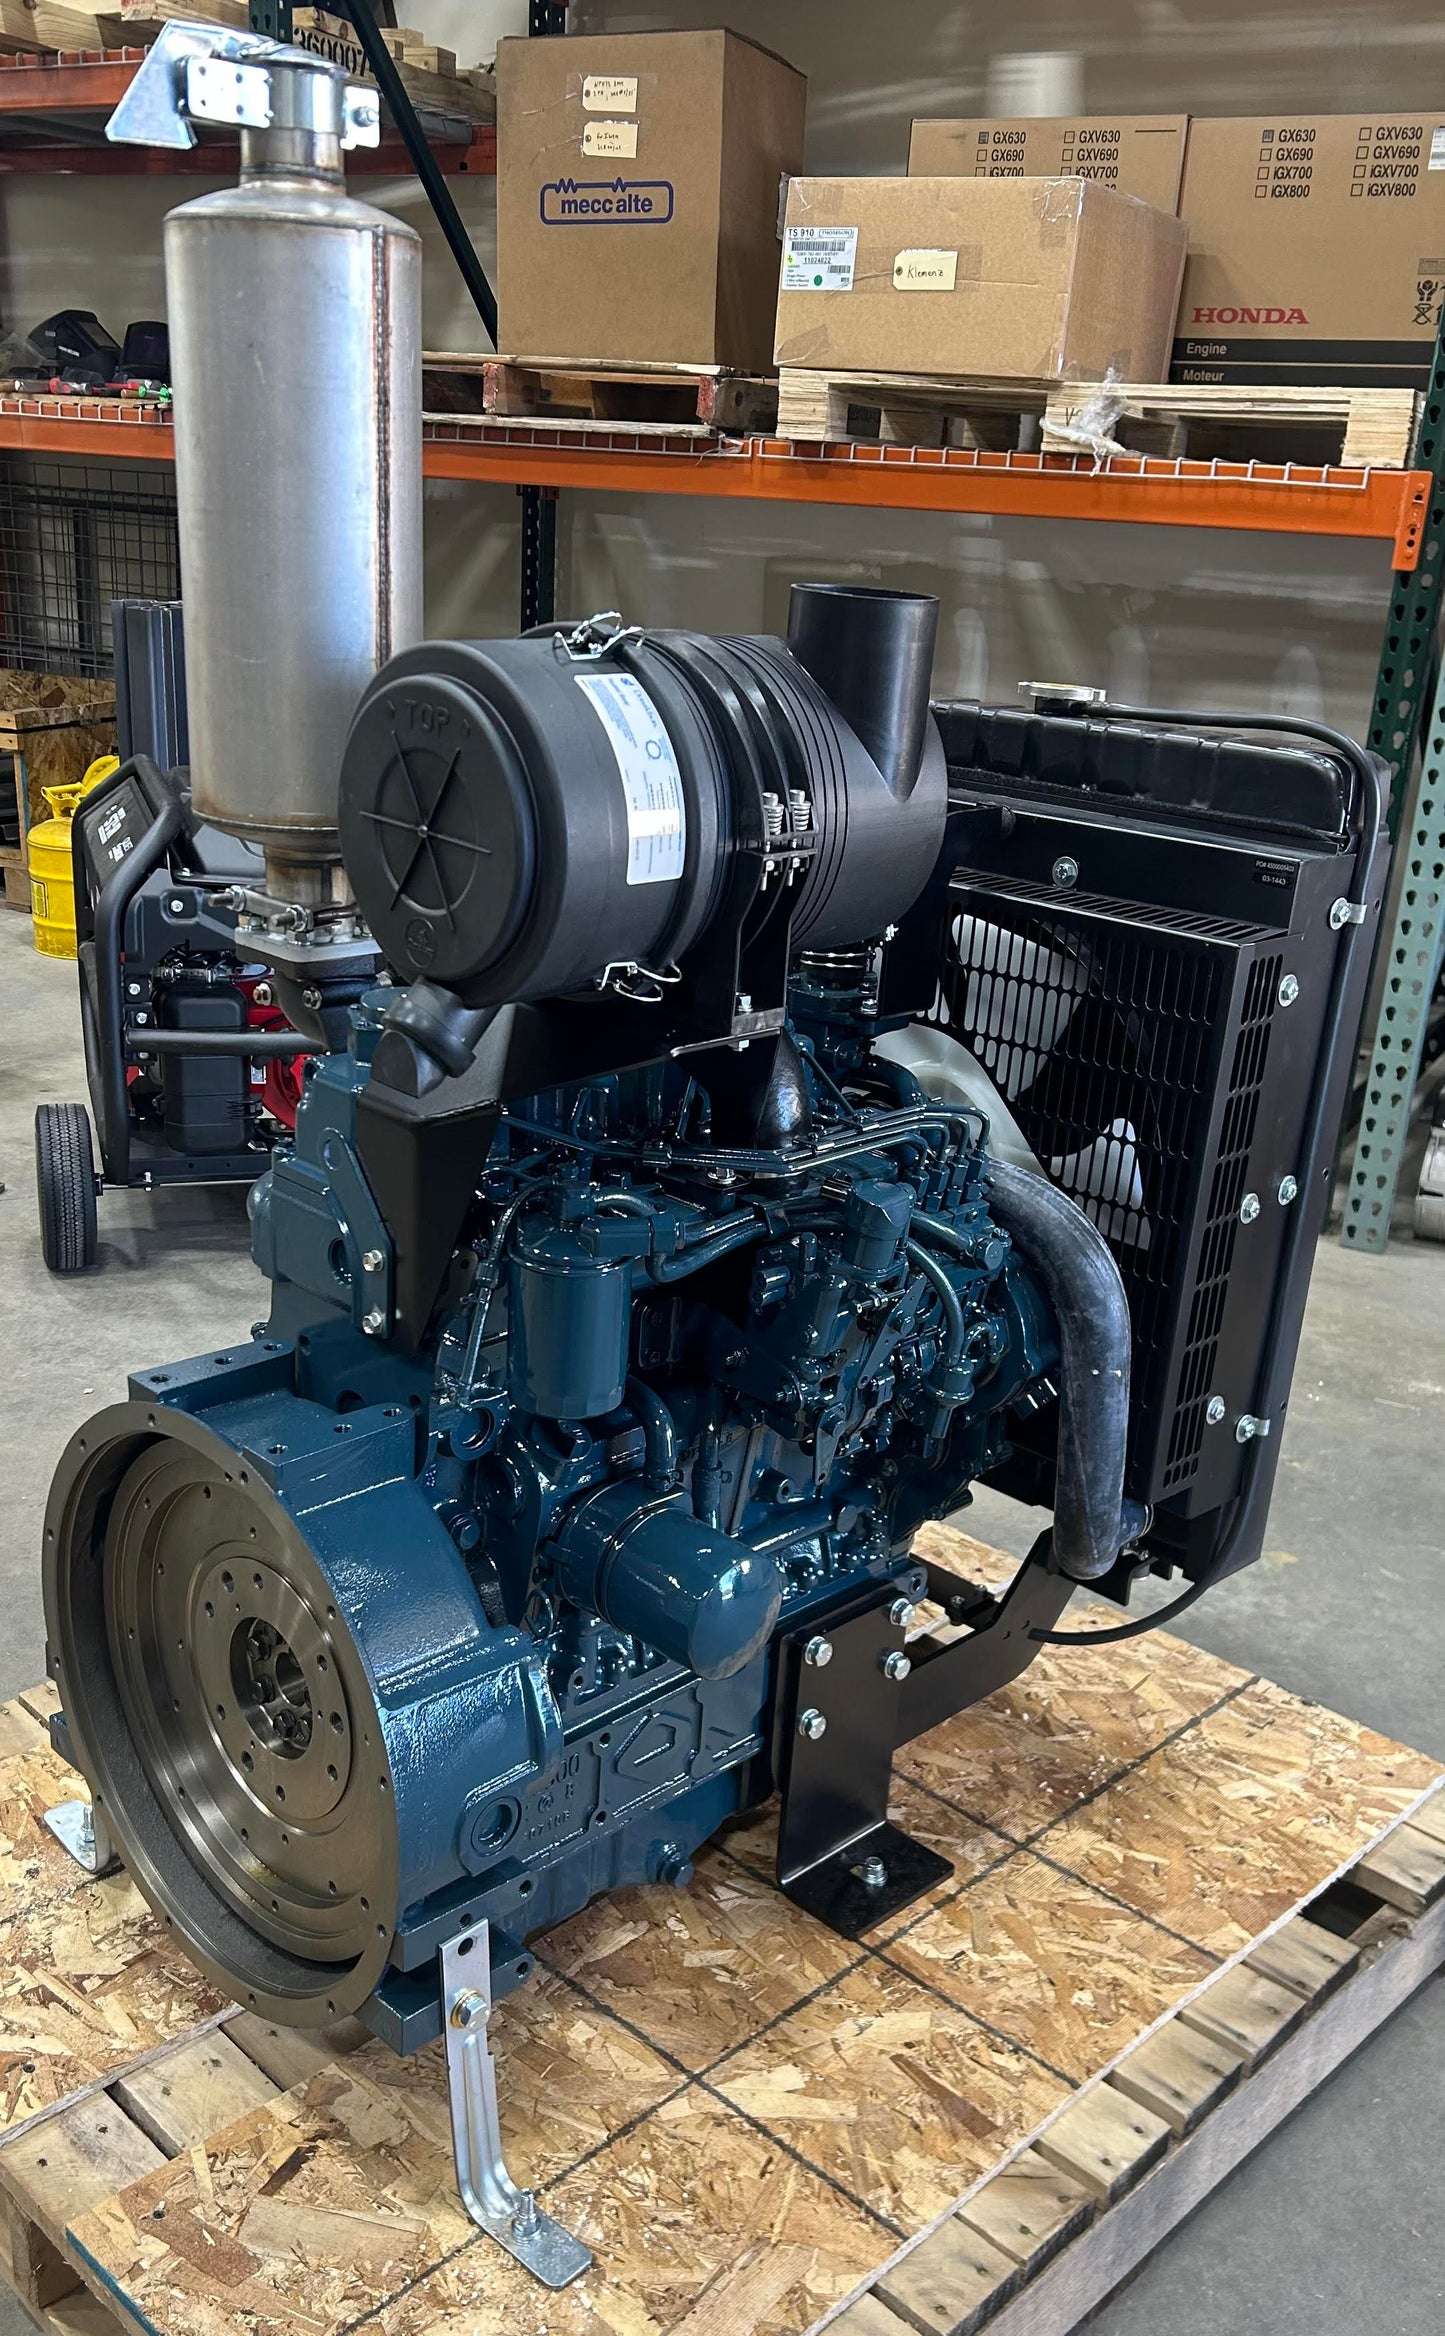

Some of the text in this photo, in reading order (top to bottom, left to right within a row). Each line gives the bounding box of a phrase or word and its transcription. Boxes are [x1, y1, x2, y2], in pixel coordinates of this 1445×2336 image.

[992, 131, 1027, 145] GX630
[1079, 130, 1120, 143] GXV630
[1278, 129, 1316, 143] GX630
[1376, 127, 1423, 140] GXV630
[991, 149, 1025, 162] GX690
[1077, 148, 1119, 161] GXV690
[1276, 147, 1313, 161] GX690
[1373, 146, 1420, 159] GXV690
[989, 166, 1025, 177] iGX700
[1075, 166, 1119, 179] iGXV700
[1273, 166, 1313, 180] iGX700
[1369, 164, 1419, 178] iGXV700
[1270, 185, 1311, 198] iGX800
[1367, 183, 1416, 197] iGXV800
[788, 228, 815, 237] TS 910
[1191, 307, 1310, 325] HONDA
[1186, 342, 1228, 357] Engine
[1183, 369, 1225, 381] Moteur
[404, 699, 450, 737] TOP
